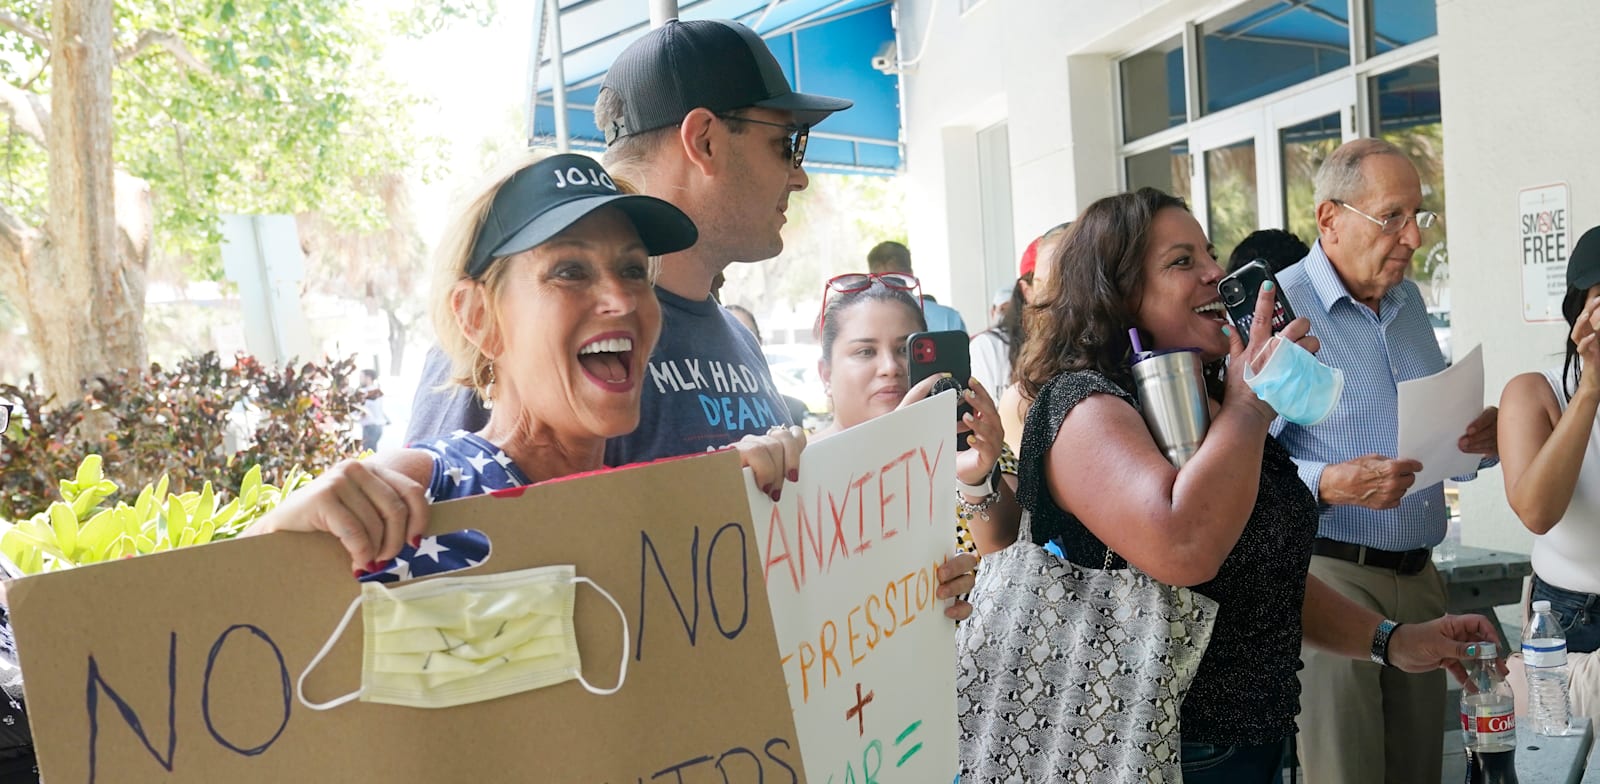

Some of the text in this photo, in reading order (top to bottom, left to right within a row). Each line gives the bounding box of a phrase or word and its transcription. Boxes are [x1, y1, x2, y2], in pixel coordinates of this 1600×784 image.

[554, 167, 617, 189] JOJO
[1522, 209, 1565, 235] SMOKE
[1523, 233, 1566, 265] FREE
[649, 359, 709, 394] MLK
[708, 361, 759, 393] HAD
[698, 394, 778, 430] DEAM
[764, 440, 944, 592] ANXIETY
[86, 522, 749, 784] NO NO
